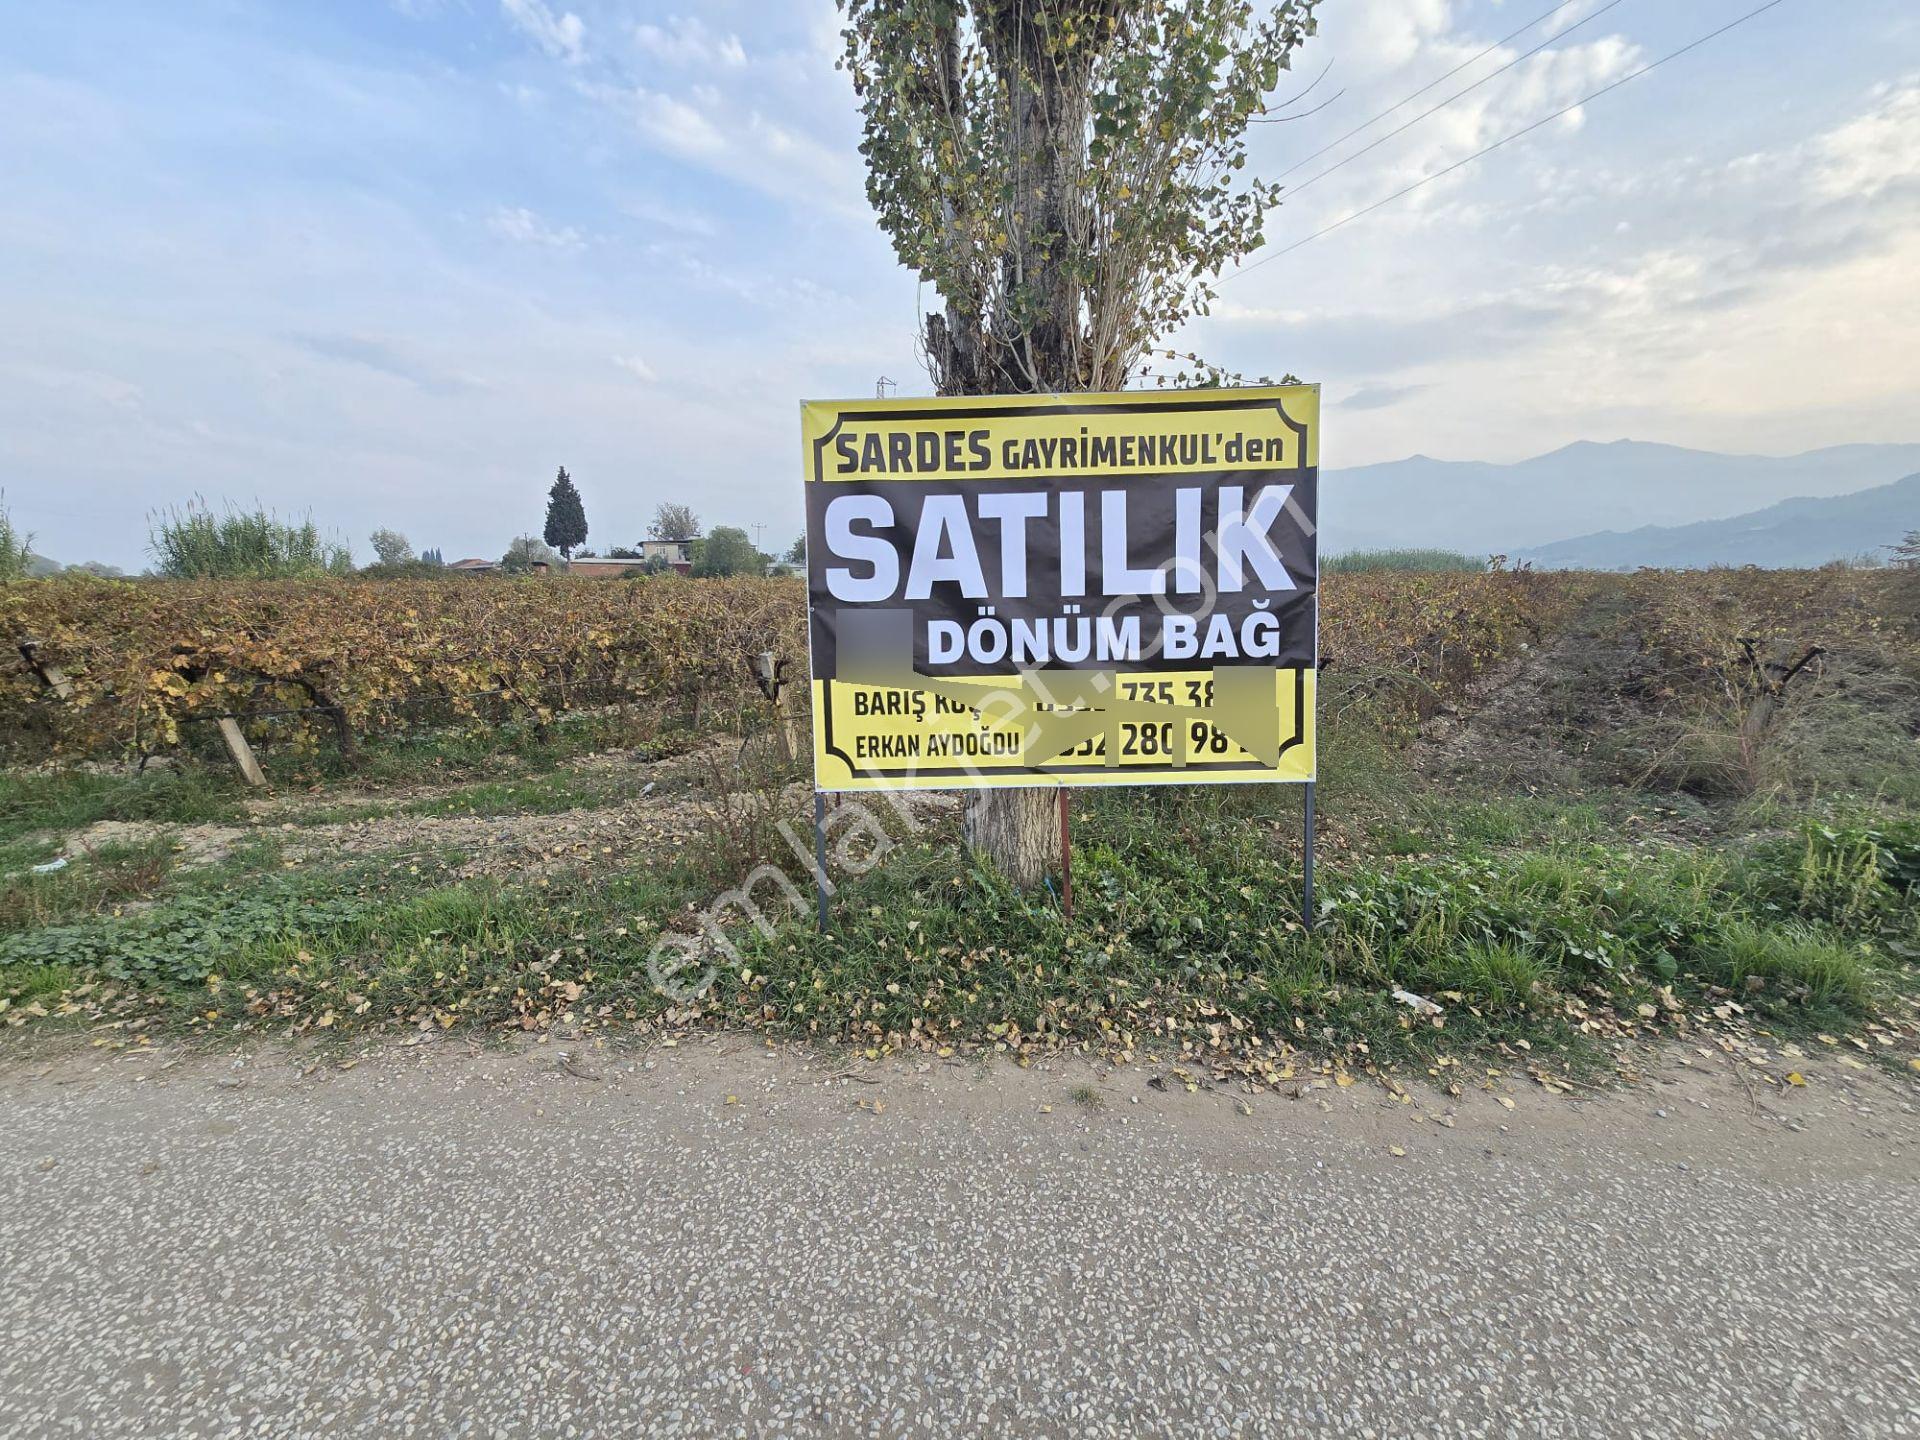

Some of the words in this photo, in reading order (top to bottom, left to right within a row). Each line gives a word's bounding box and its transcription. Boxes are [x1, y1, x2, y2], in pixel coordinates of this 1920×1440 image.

[836, 430, 991, 473] SARDES
[1002, 427, 1284, 470] GAYRİMENKUL'den
[824, 484, 1297, 603] SATILIK
[928, 604, 1141, 665] DÖNÜM
[1162, 598, 1281, 661] BAĞ
[854, 690, 926, 723] BARIŞ
[856, 734, 920, 758] ERKAN
[927, 725, 1020, 758] AYDOĞDU
